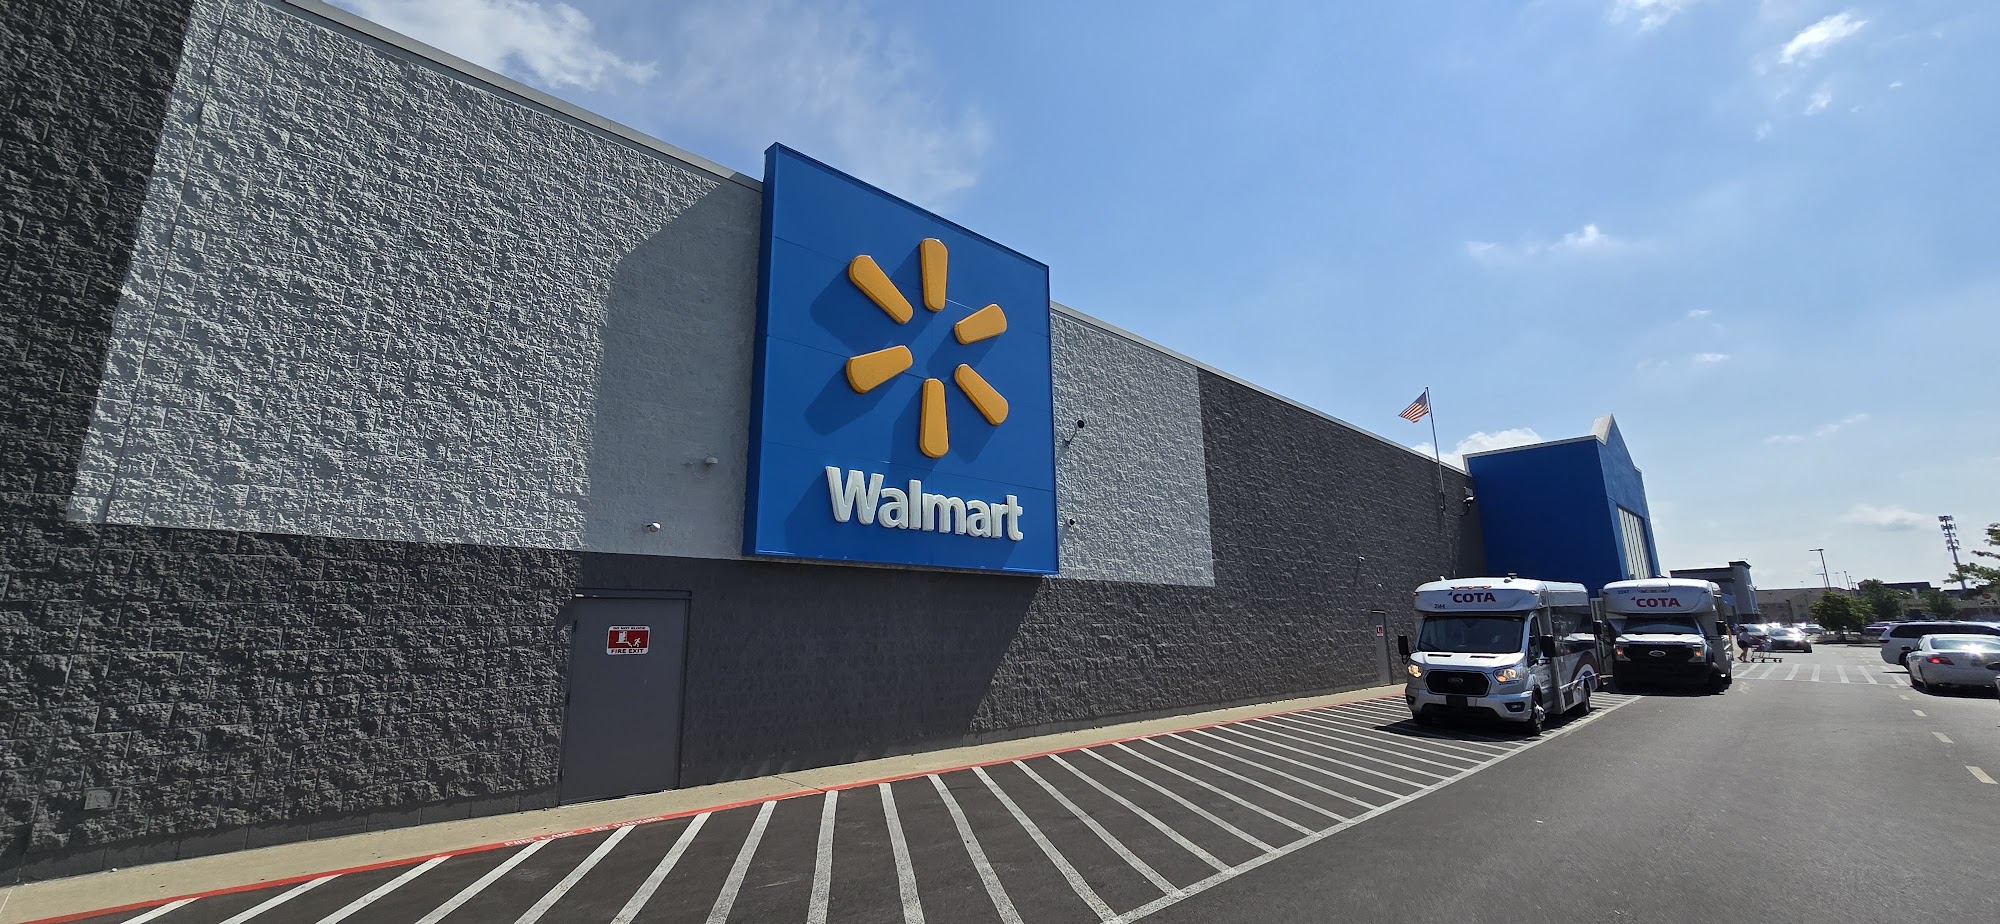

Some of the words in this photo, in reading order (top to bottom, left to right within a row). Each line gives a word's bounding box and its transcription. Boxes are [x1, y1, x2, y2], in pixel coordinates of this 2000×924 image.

[826, 466, 1023, 541] Walmart
[1453, 592, 1496, 603] COTA
[1636, 597, 1681, 608] COTA
